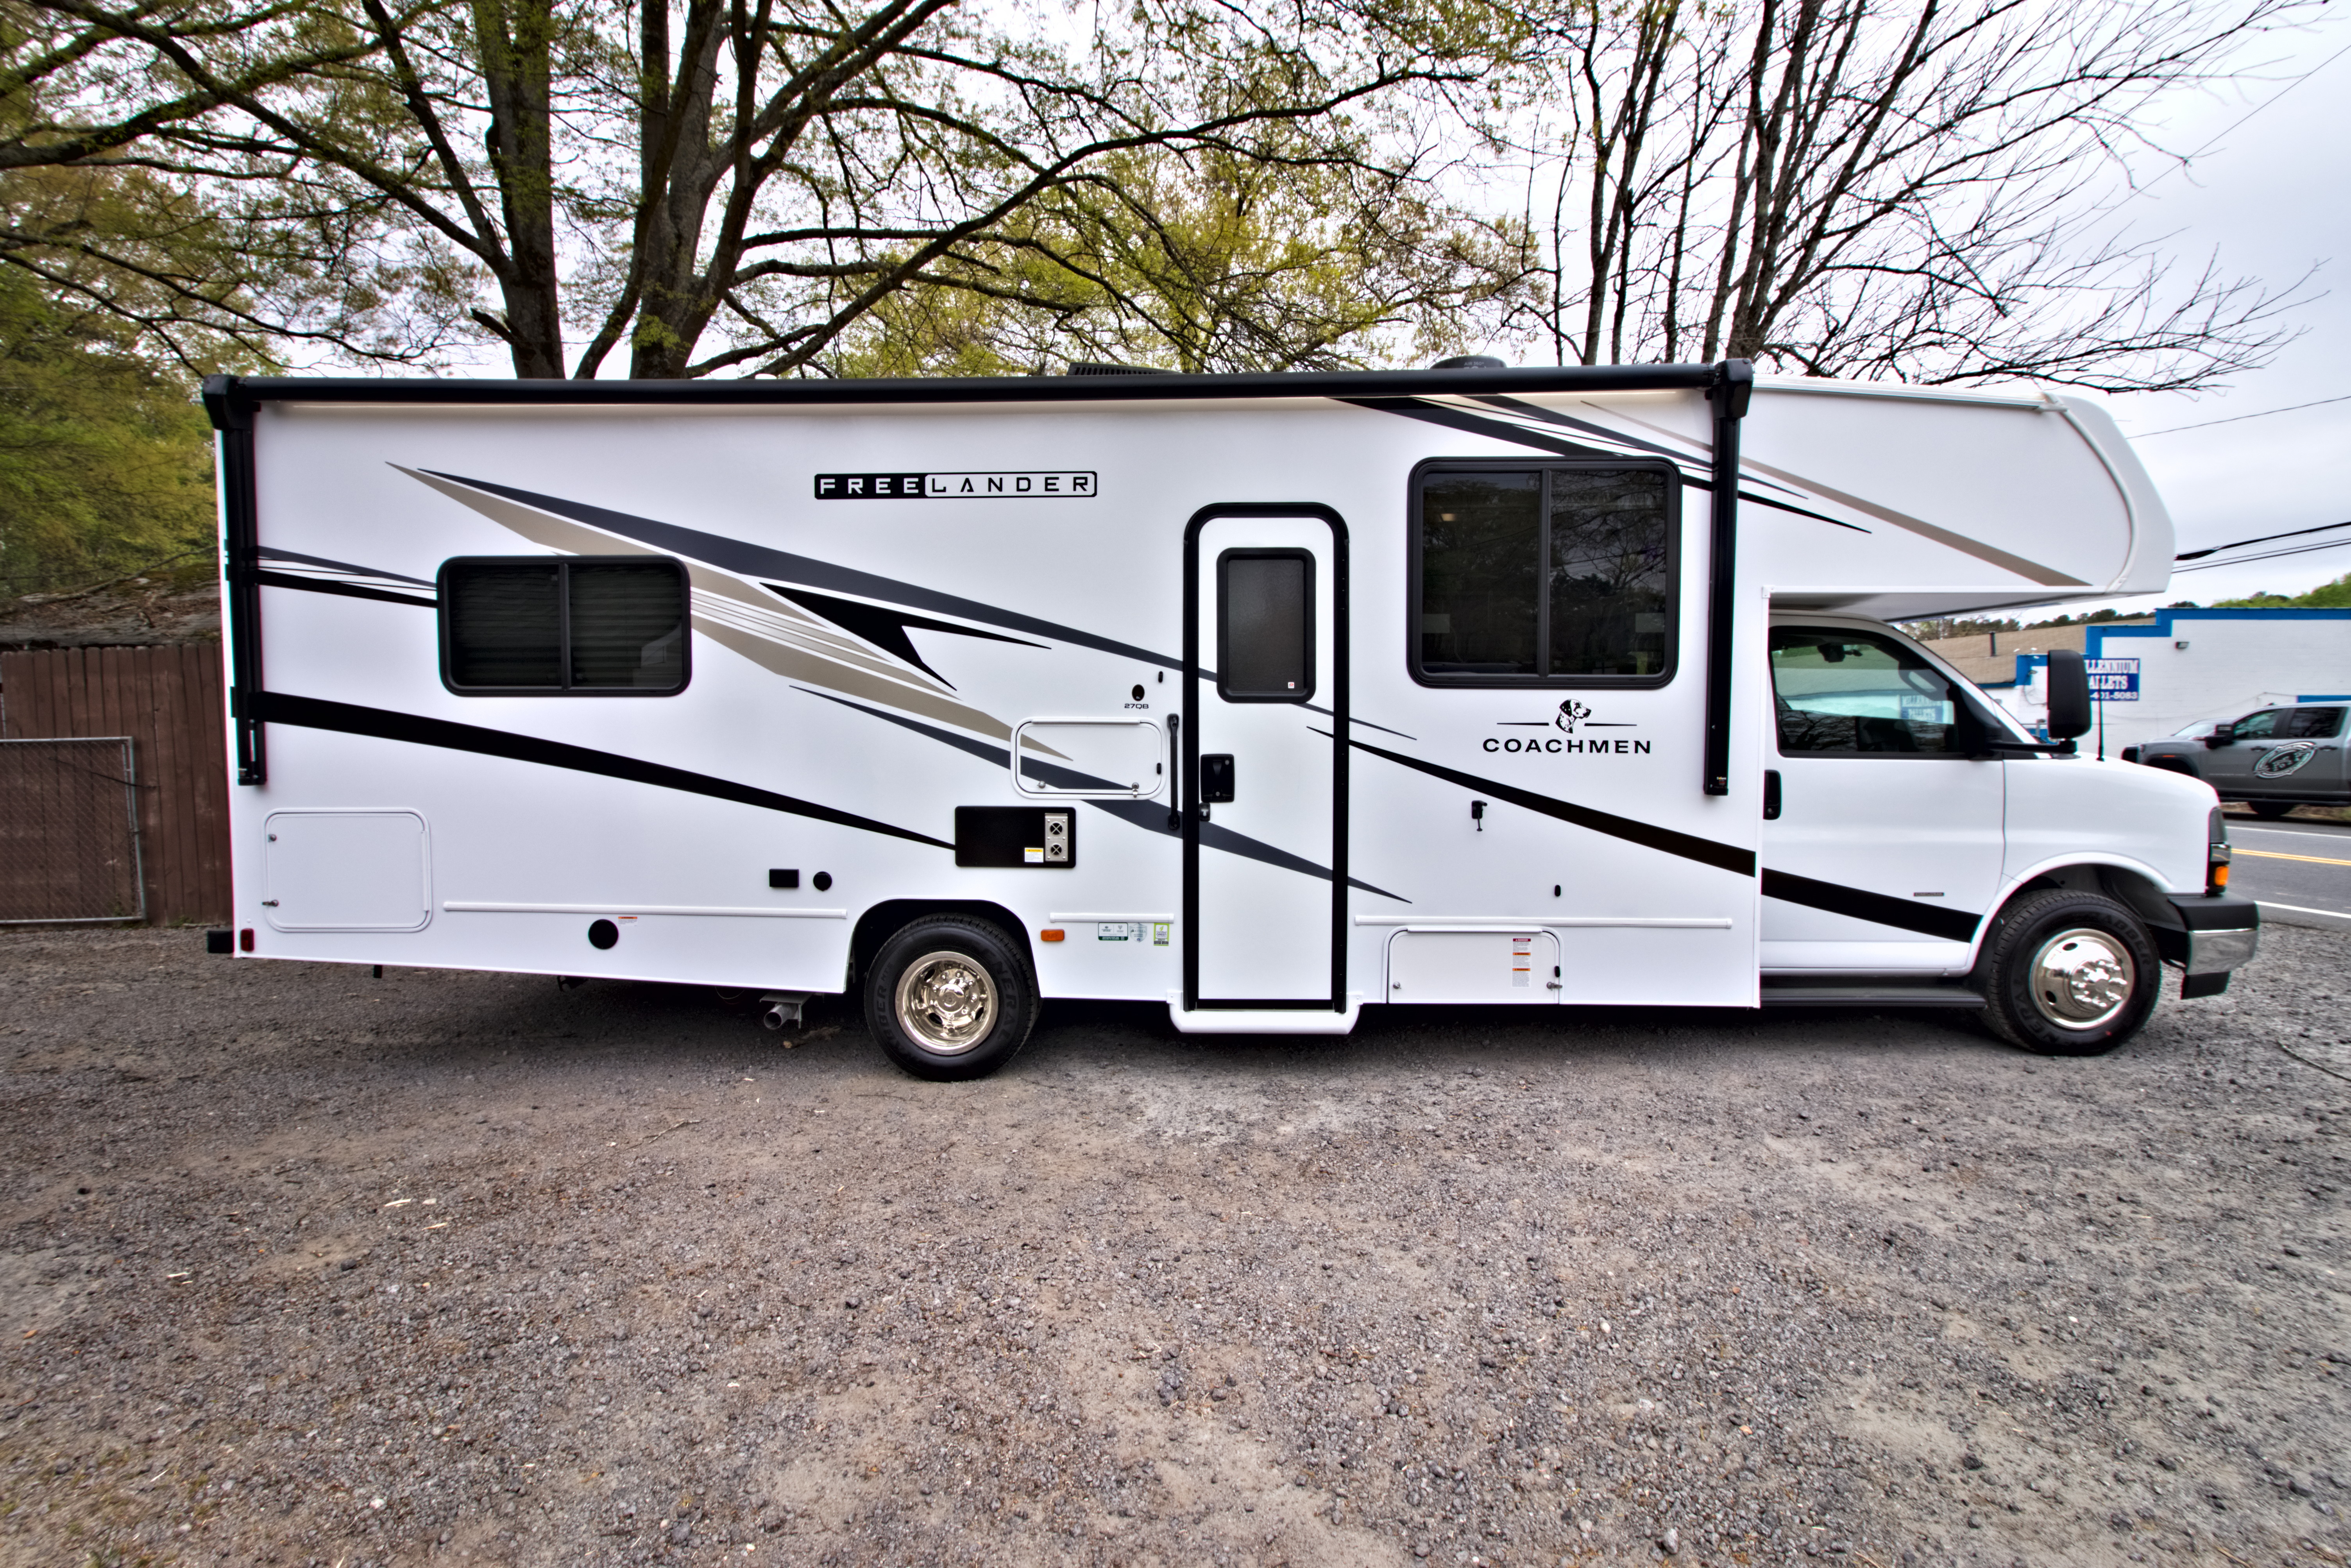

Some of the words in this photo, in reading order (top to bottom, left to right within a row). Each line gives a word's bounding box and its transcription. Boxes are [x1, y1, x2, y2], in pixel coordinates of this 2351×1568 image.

[819, 476, 1088, 494] FREELANDER
[2084, 659, 2138, 674] LLENNIUM
[2089, 675, 2128, 689] ALLETS
[1483, 738, 1650, 754] COACHMEN
